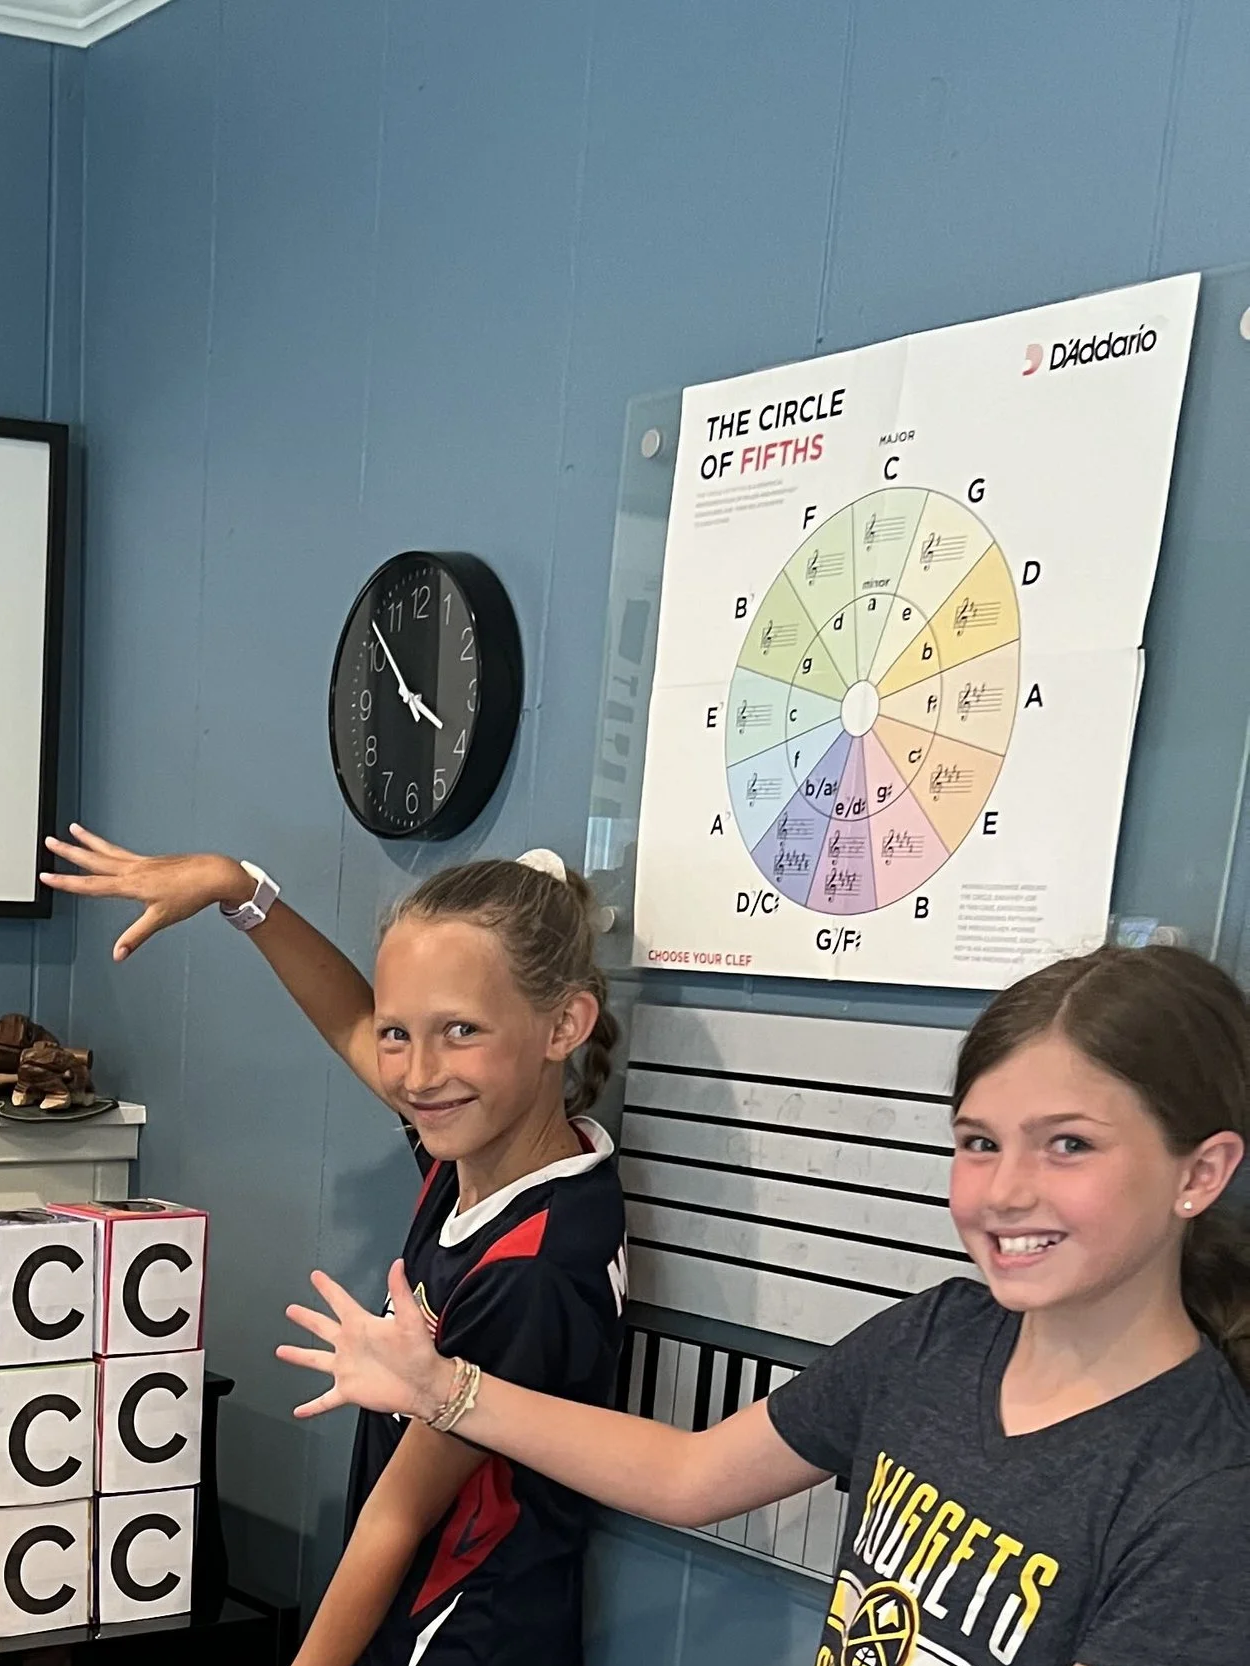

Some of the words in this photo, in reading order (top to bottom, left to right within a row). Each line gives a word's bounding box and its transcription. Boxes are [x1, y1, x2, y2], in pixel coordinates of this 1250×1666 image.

[707, 409, 751, 442] THE
[759, 388, 846, 431] CIRCLE
[879, 430, 915, 447] MAJOR
[701, 451, 734, 479] OF
[740, 434, 824, 474] FIFTHS
[883, 456, 900, 480] C
[967, 478, 986, 503] G
[803, 505, 817, 530] F
[1022, 561, 1041, 587] D
[388, 601, 403, 633] 11
[411, 585, 431, 620] 12
[443, 593, 452, 625] 1
[901, 607, 911, 621] e
[833, 613, 844, 631] d
[368, 640, 387, 673] 10
[460, 627, 474, 661] 2
[921, 642, 933, 661] b
[802, 657, 813, 675] g
[360, 690, 372, 721] 9
[1024, 683, 1044, 709] A
[789, 708, 798, 723] c
[364, 735, 378, 767] 8
[453, 729, 467, 759] 4
[381, 771, 394, 802] 7
[405, 782, 419, 814] 6
[433, 768, 447, 801] 5
[983, 811, 999, 836] E
[914, 896, 929, 920] B
[648, 950, 690, 964] CHOOSE
[693, 953, 723, 966] YOUR
[725, 954, 753, 968] CLEF
[12, 1244, 85, 1341] C
[122, 1243, 193, 1338] C
[8, 1394, 82, 1488] C
[117, 1371, 188, 1464] C
[3, 1524, 77, 1616] C
[110, 1513, 182, 1602] C
[853, 1451, 1060, 1666] NUGGETS
